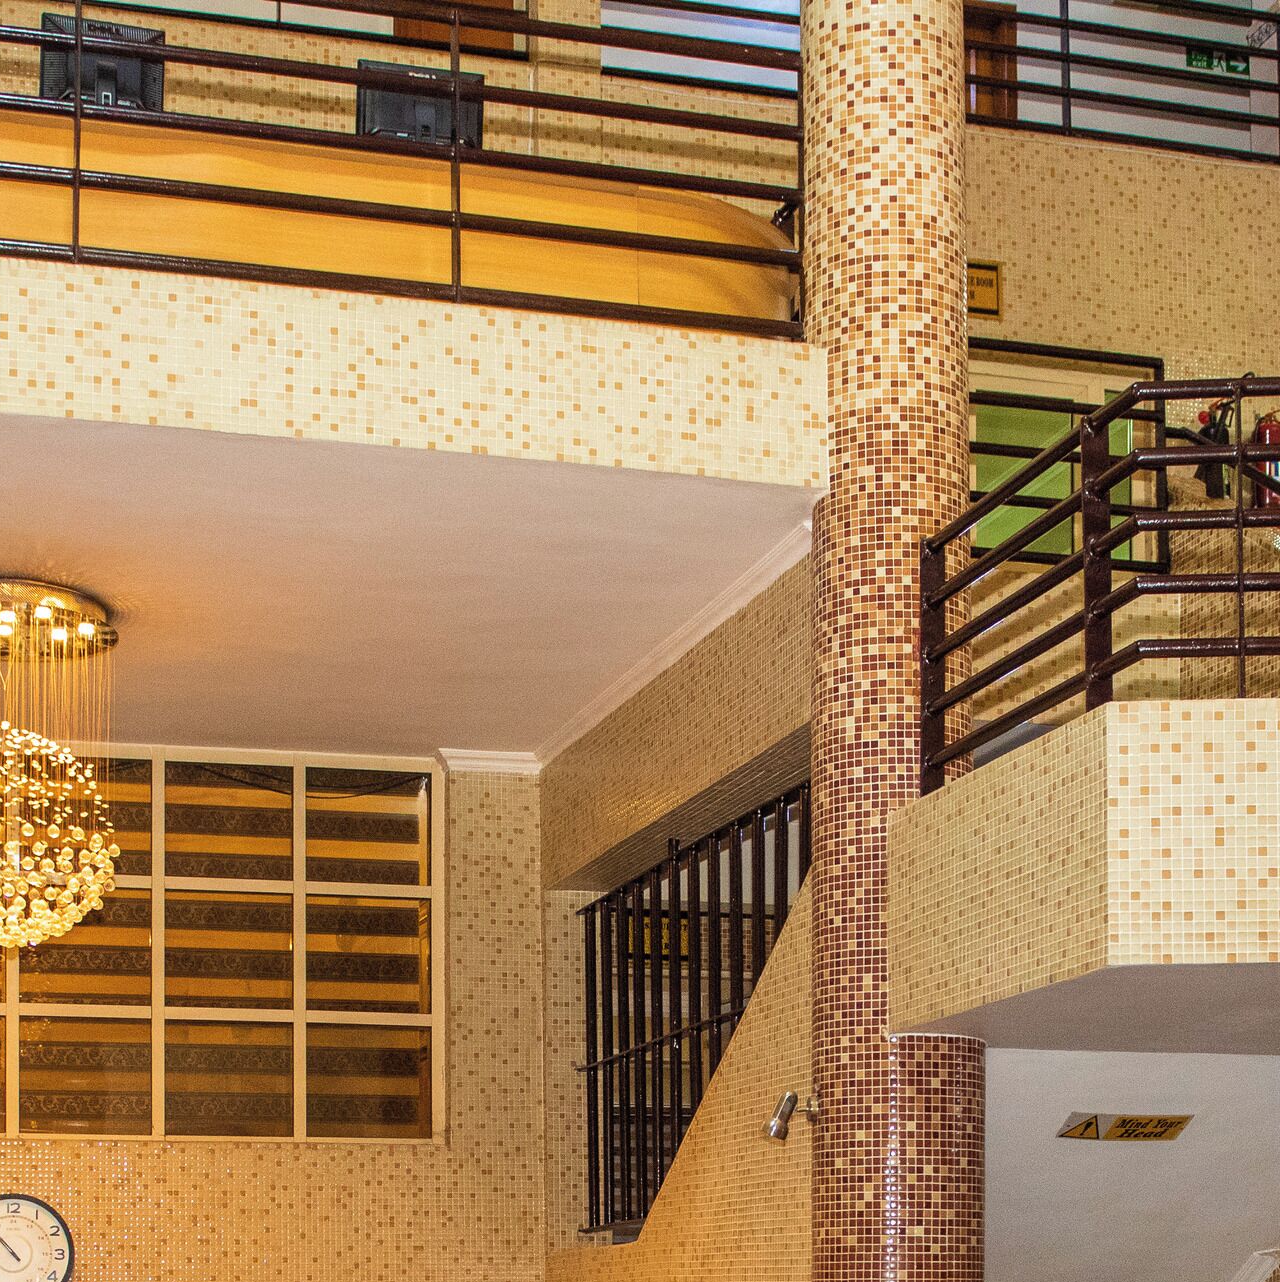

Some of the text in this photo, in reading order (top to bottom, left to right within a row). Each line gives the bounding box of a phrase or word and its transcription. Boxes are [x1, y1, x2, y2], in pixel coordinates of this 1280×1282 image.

[1116, 1118, 1183, 1128] Mind Your
[1116, 1128, 1169, 1137] Head
[7, 1202, 21, 1213] 12
[49, 1225, 61, 1236] 2
[54, 1248, 65, 1260] 3
[46, 1270, 59, 1281] 4
